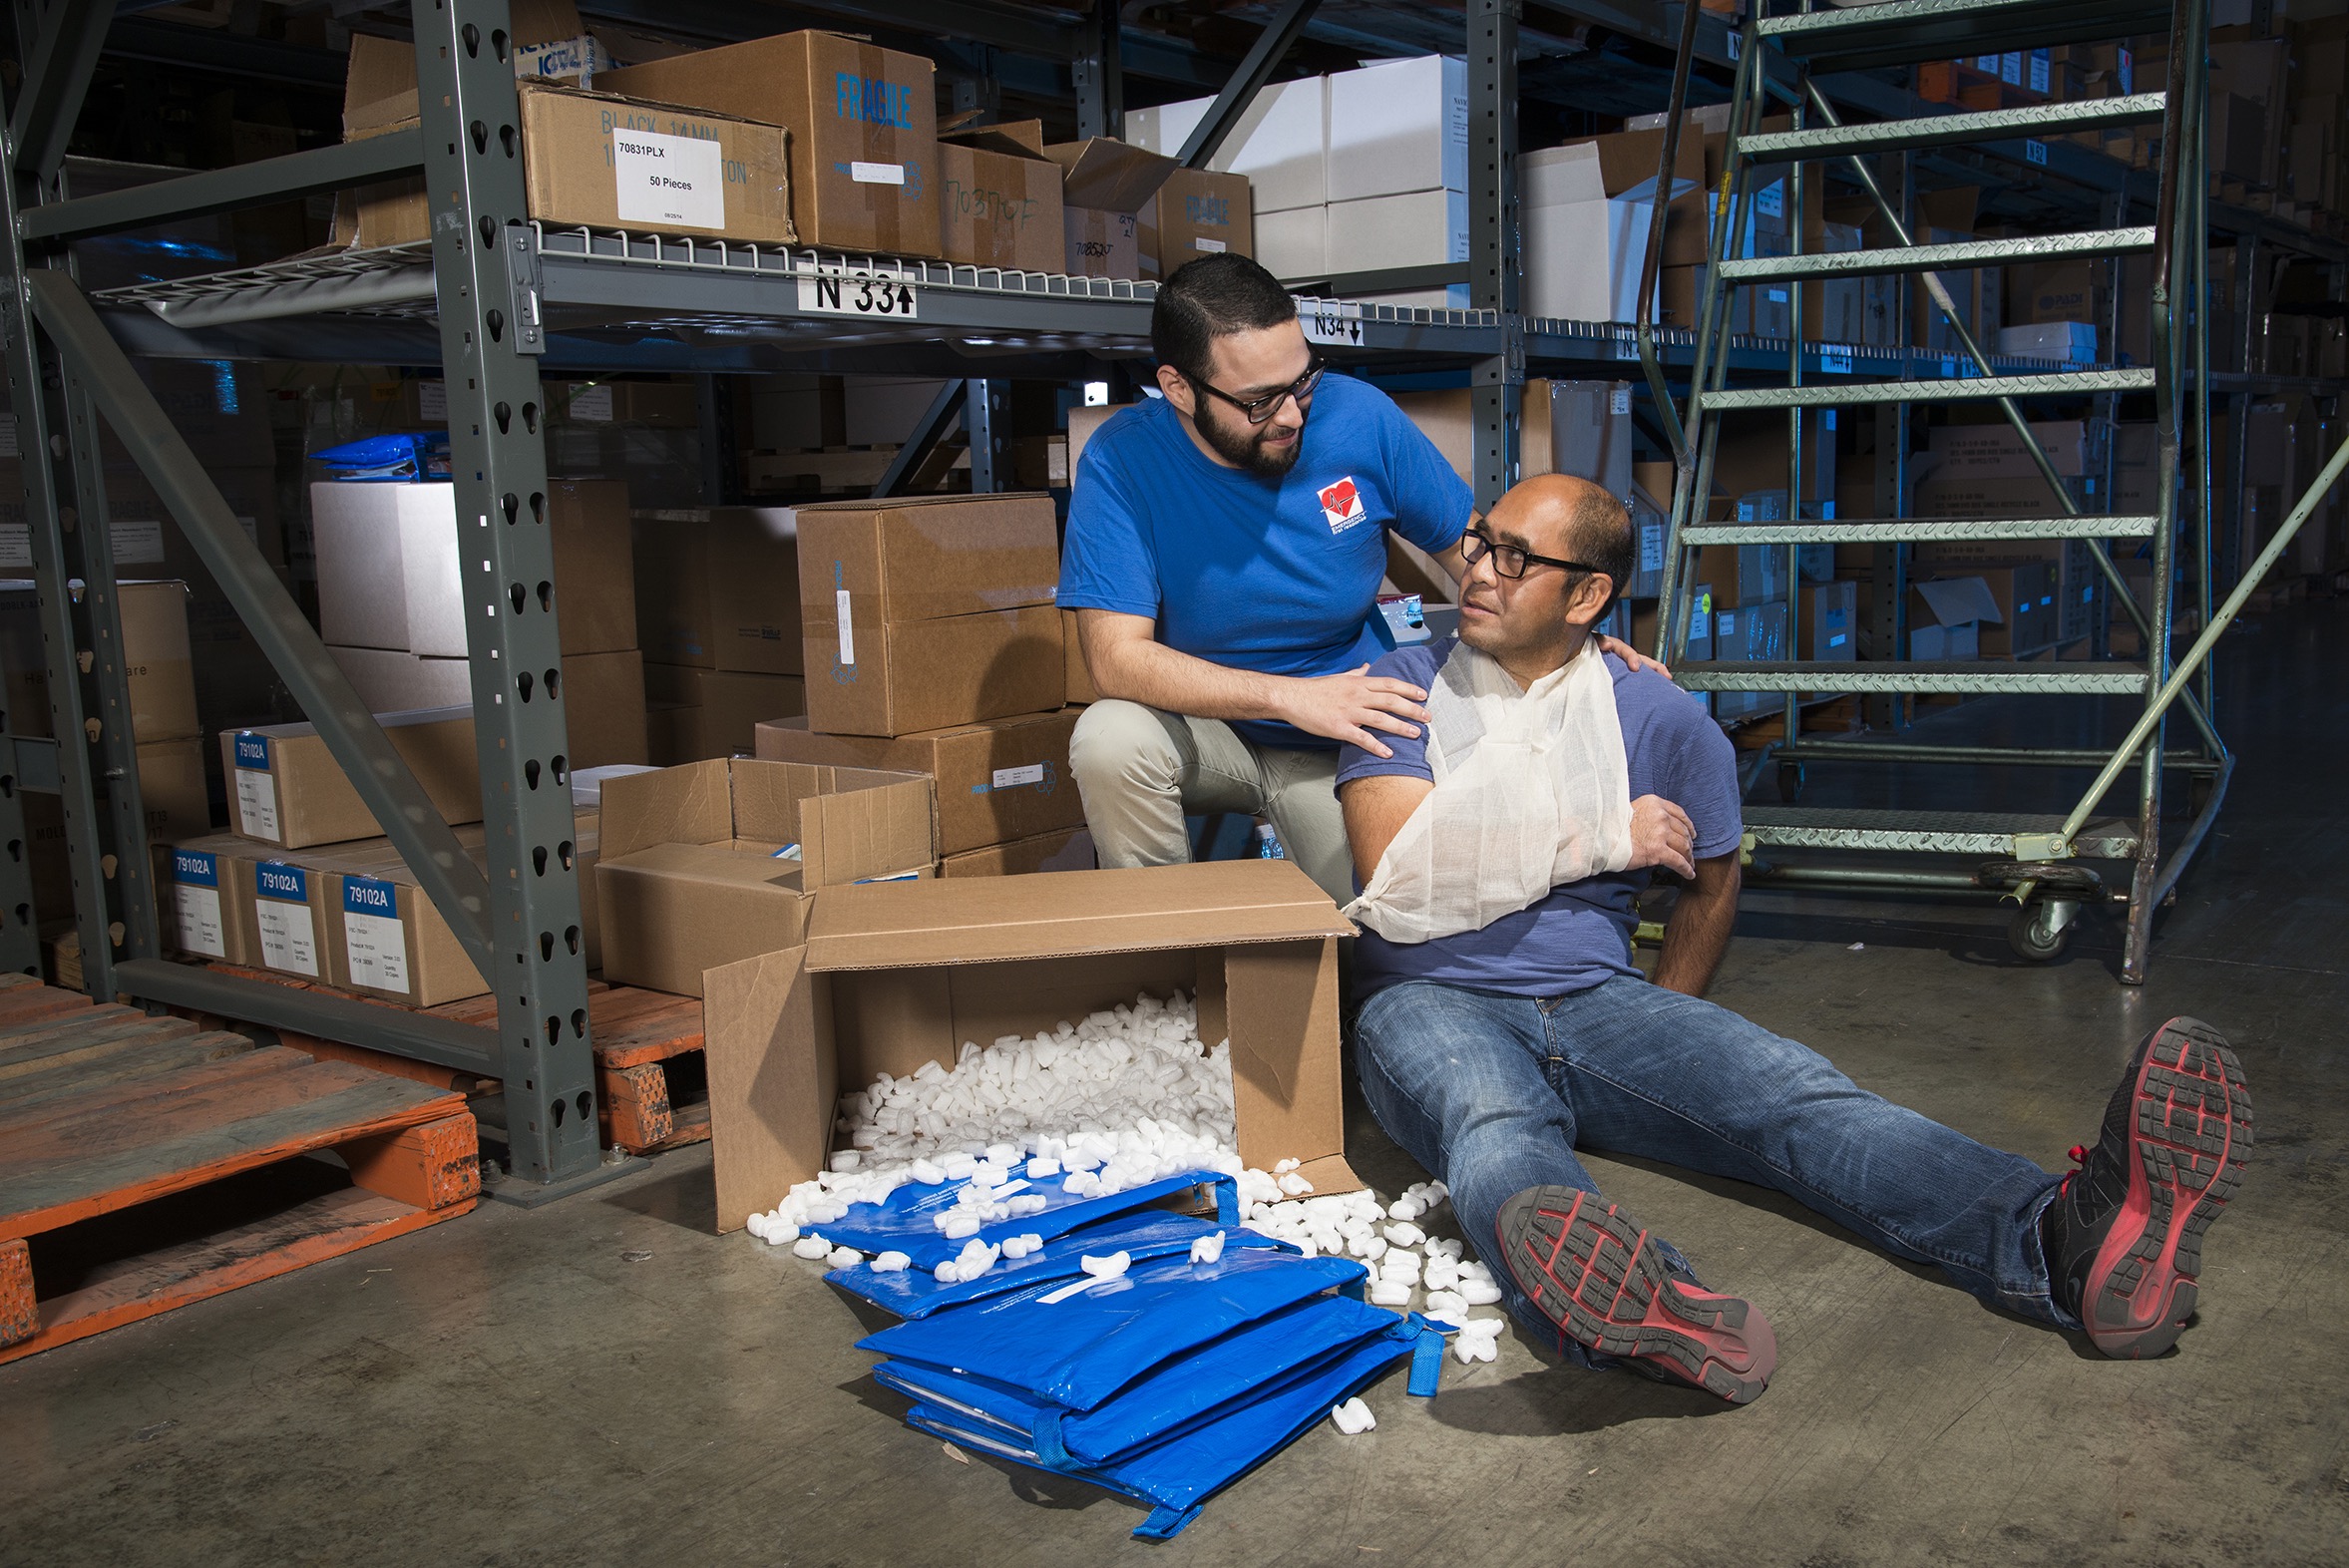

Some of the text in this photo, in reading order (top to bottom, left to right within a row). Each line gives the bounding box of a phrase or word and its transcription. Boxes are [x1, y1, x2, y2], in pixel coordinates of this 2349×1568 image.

[836, 71, 913, 131] FRAGILE
[618, 142, 665, 159] 70831PLX
[649, 176, 692, 191] 50 Pieces
[1186, 195, 1230, 226] FRAGILE
[817, 266, 895, 313] N 33
[2055, 293, 2083, 305] PADI
[1315, 311, 1345, 336] N34
[1332, 511, 1367, 531] EMERGENCY
[126, 665, 148, 676] are
[238, 742, 265, 759] 79102A
[177, 856, 210, 875] 79102A
[262, 872, 299, 893] 79102A
[349, 886, 389, 908] 79102A
